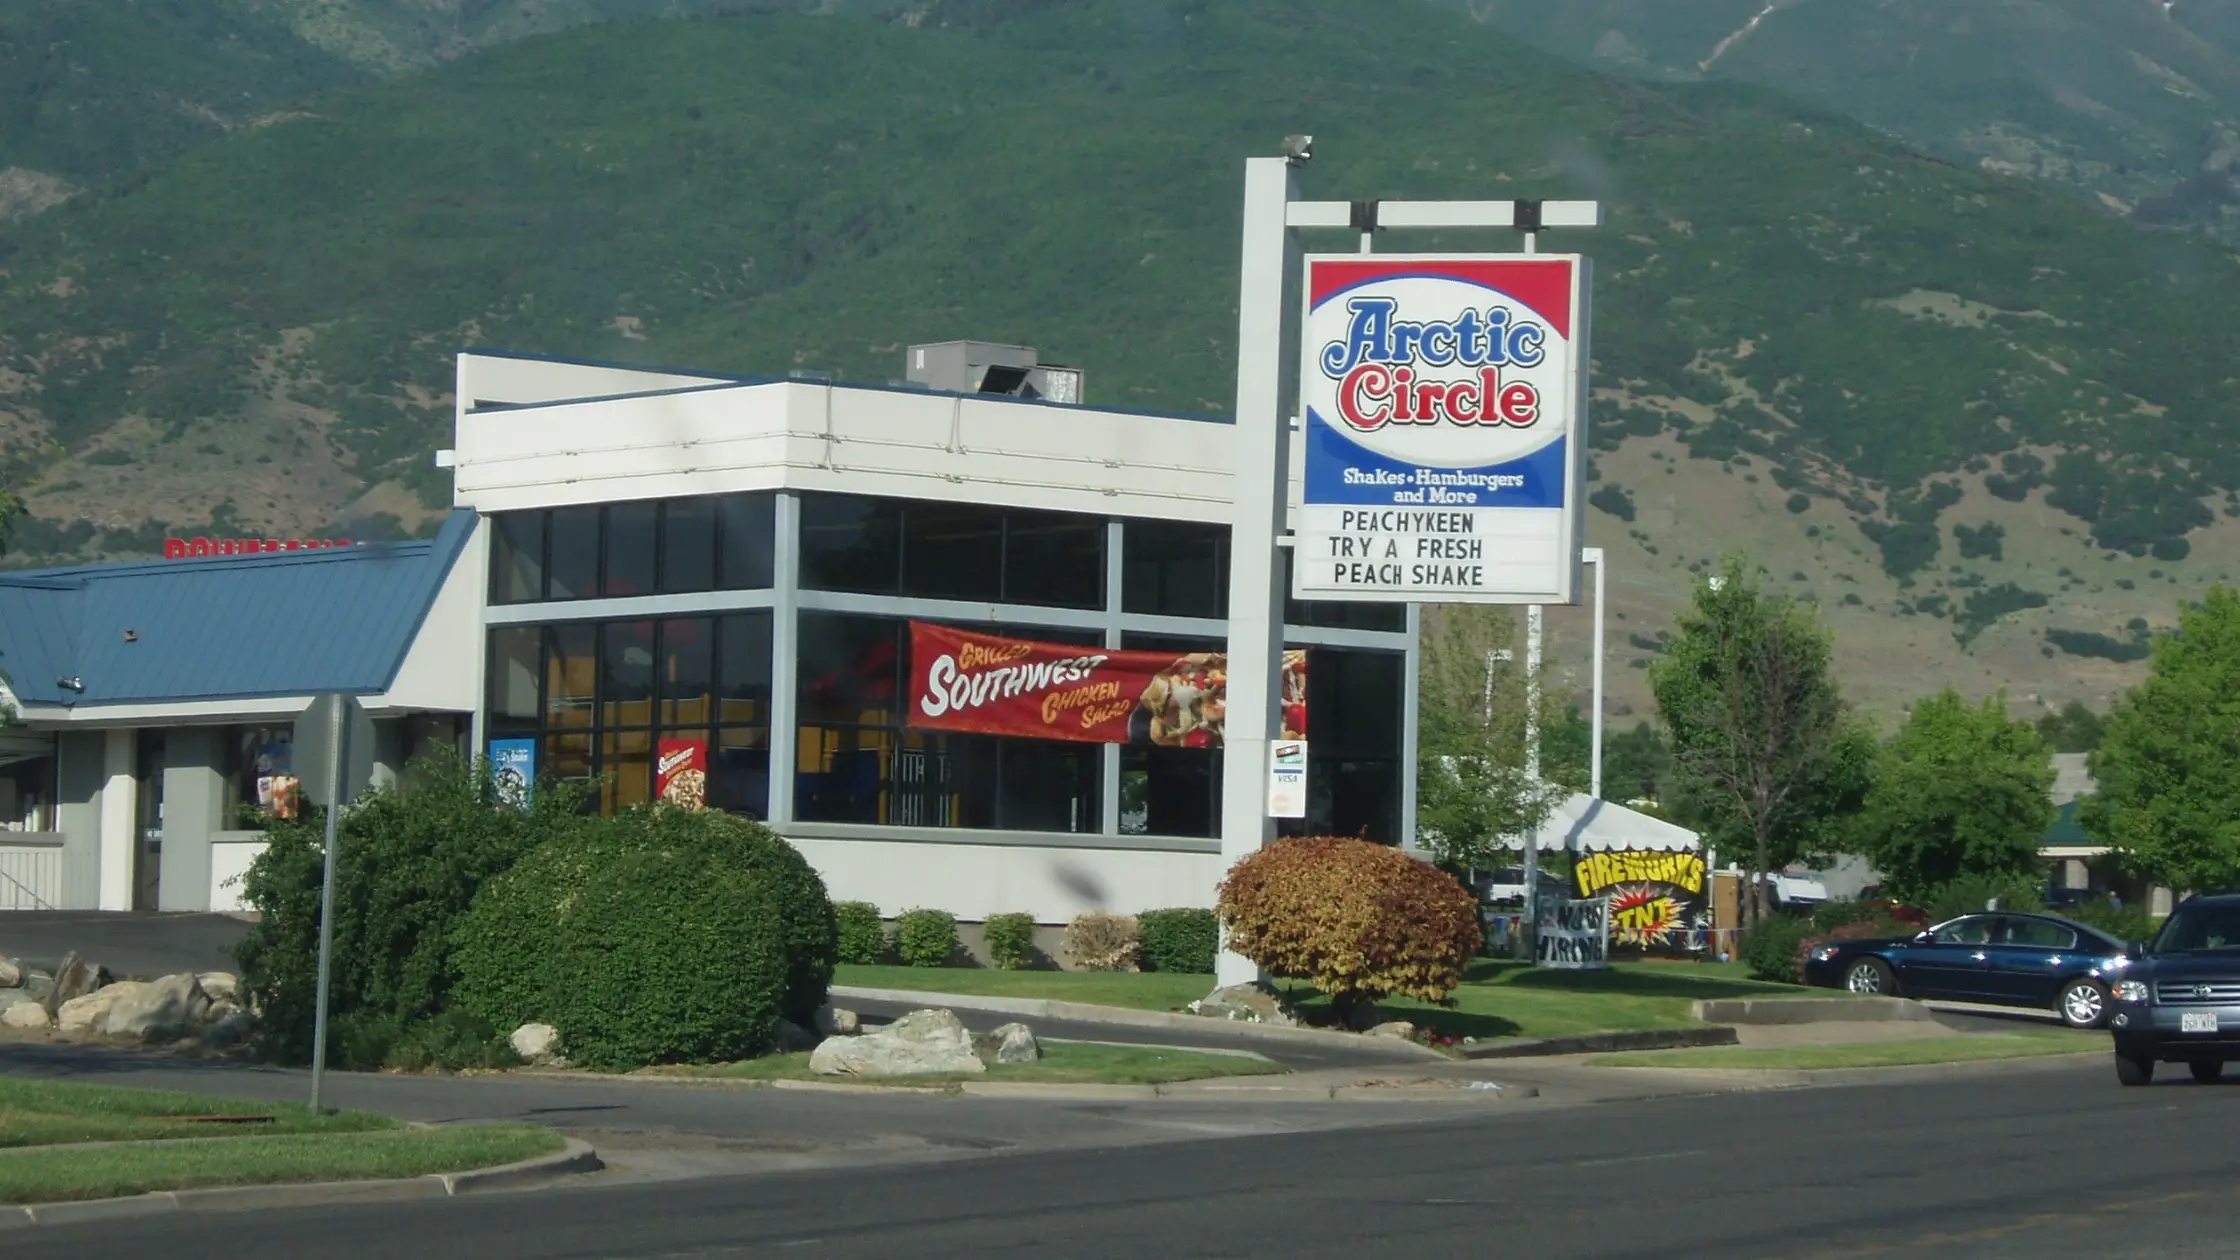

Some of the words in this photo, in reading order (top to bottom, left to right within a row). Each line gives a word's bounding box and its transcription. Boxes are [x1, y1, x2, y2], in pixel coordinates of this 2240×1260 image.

[1320, 297, 1545, 379] Arctic
[1337, 363, 1540, 432] Circle
[1415, 469, 1524, 491] Hamburgers
[1394, 488, 1424, 503] and
[1428, 488, 1477, 504] More
[1342, 510, 1473, 533] PEACHYKEEN
[1329, 537, 1372, 557] TRY
[1385, 539, 1398, 558] A
[1417, 538, 1482, 559] FRESH
[1334, 563, 1402, 585] PEACH
[1412, 565, 1483, 586] SHAKE
[958, 642, 1034, 670] GRILLED
[920, 654, 1108, 717] SOUTHWEST
[1041, 681, 1121, 724] CHICKEN
[1080, 699, 1130, 729] SALAD
[1278, 775, 1298, 783] VISA
[1617, 897, 1669, 930] TNT
